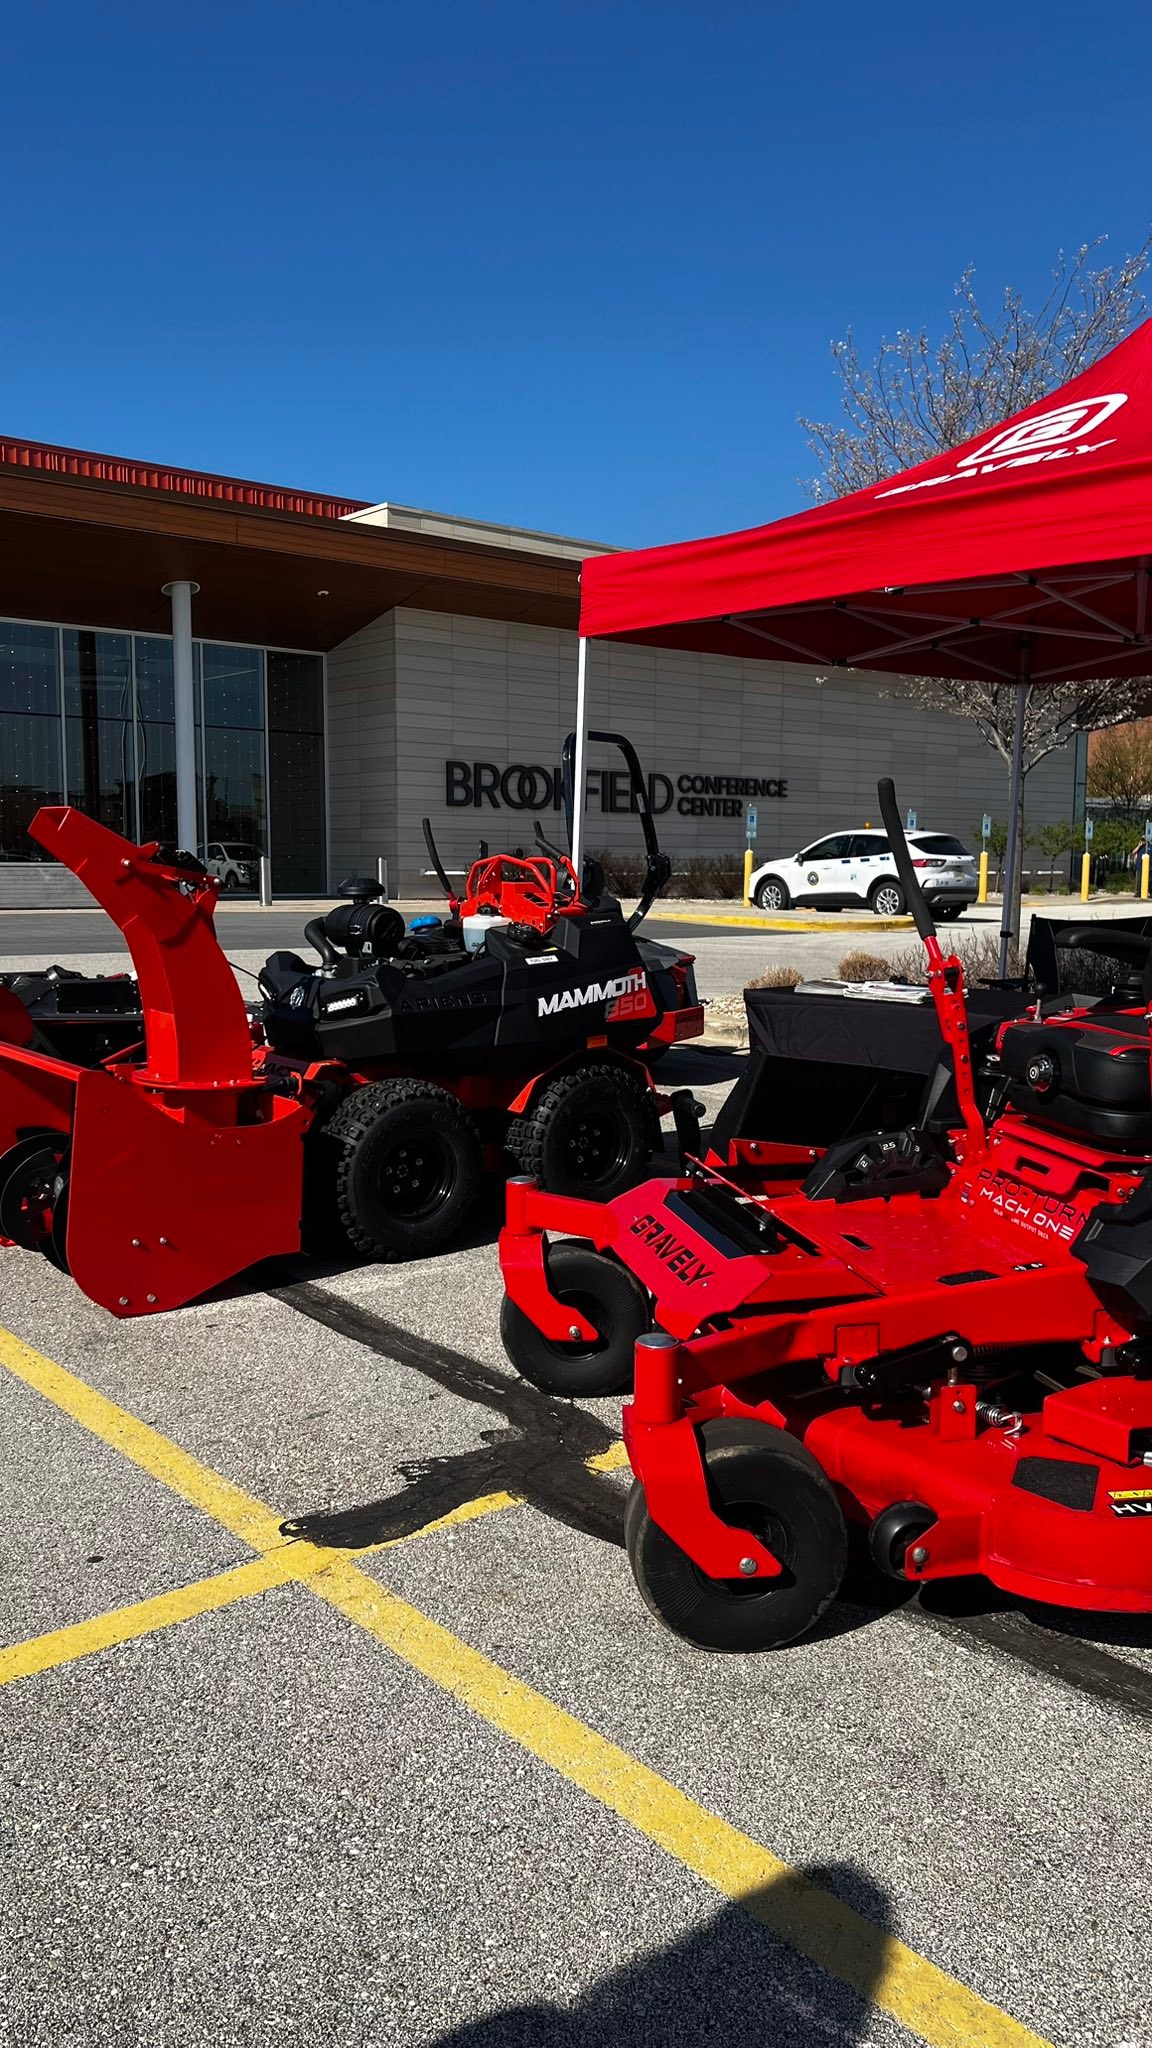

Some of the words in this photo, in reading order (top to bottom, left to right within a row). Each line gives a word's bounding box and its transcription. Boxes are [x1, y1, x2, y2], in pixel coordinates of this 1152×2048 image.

[677, 774, 788, 798] CONFERENCE
[677, 796, 743, 817] CENTER
[538, 971, 646, 1017] MAMMOTH
[604, 992, 647, 1022] 850
[980, 1187, 1030, 1218] MACH
[1033, 1212, 1075, 1241] ONE
[628, 1213, 714, 1286] GRAVELY
